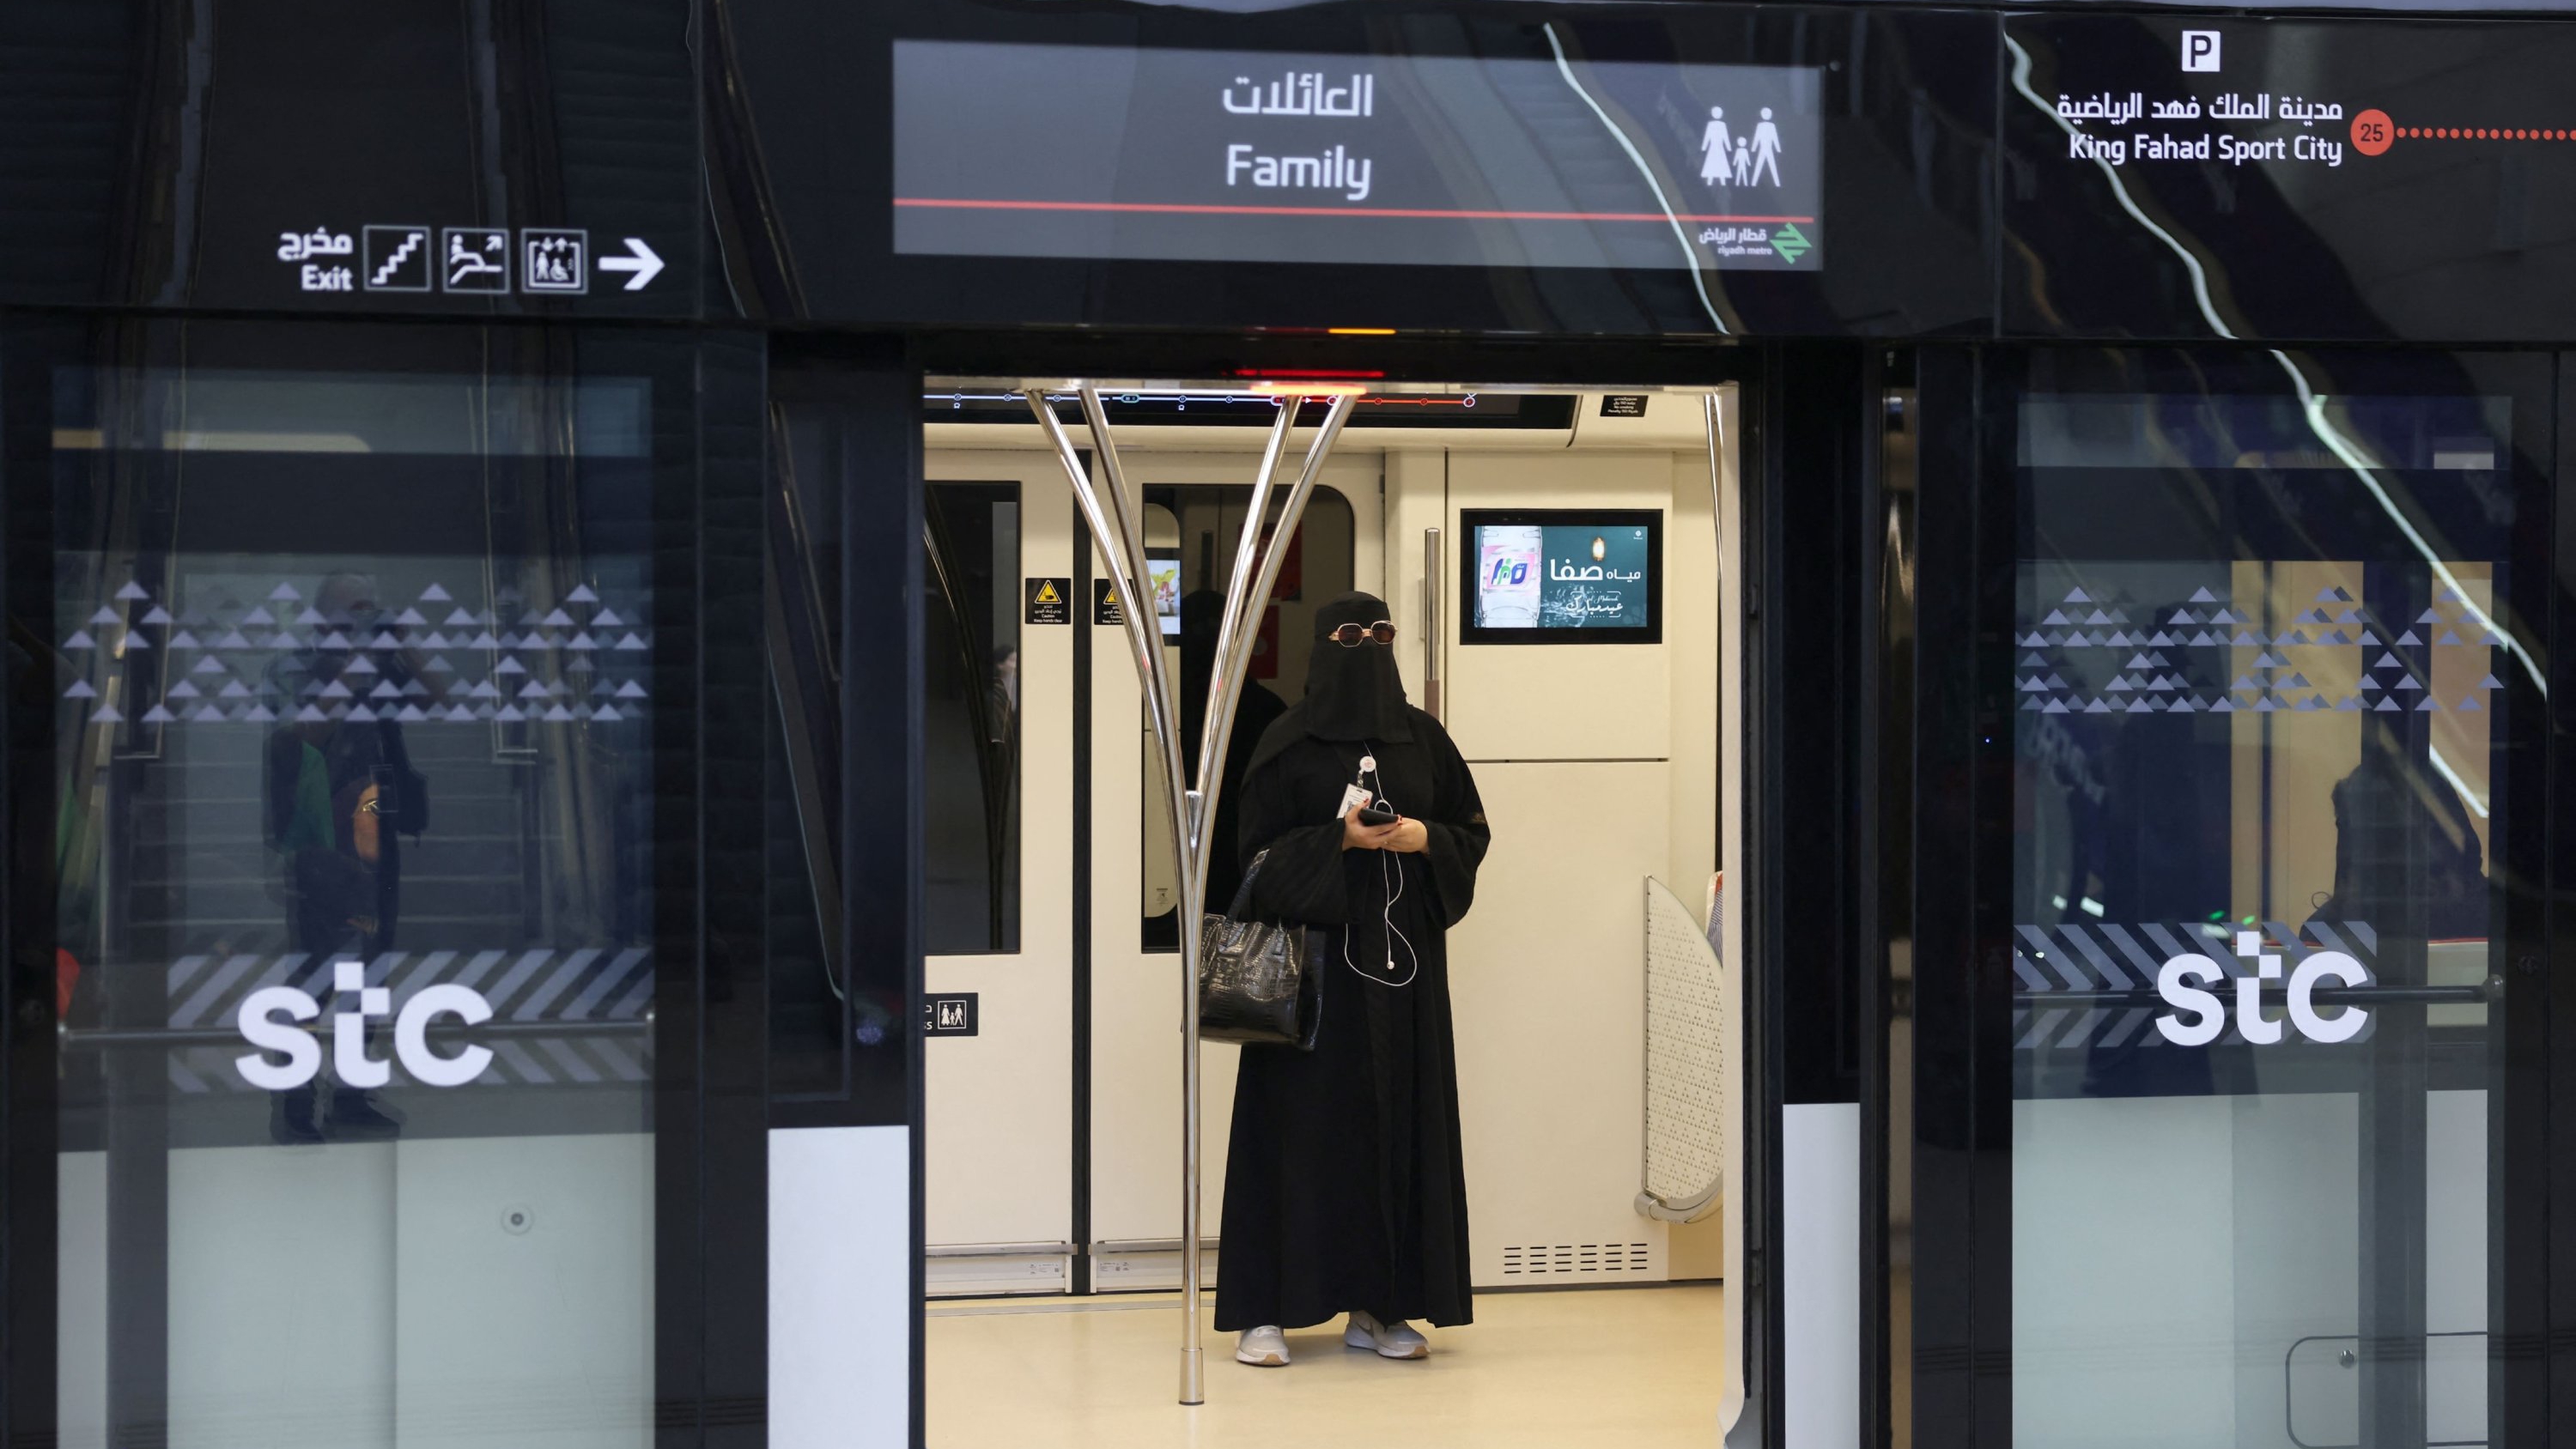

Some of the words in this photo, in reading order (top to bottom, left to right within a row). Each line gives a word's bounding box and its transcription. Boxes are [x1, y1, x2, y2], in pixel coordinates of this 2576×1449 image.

[1223, 72, 1373, 117] العائلات
[2057, 91, 2142, 125] الرياضية
[2150, 95, 2201, 119] فهد
[2208, 94, 2270, 119] الملك
[2279, 95, 2342, 127] مدينة
[2360, 124, 2384, 142] 25
[2069, 133, 2126, 166] King
[2135, 133, 2209, 160] Fahad
[2218, 135, 2286, 167] Sport
[2293, 135, 2342, 167] City
[1227, 143, 1371, 201] Family
[277, 226, 353, 261] مخرج
[1698, 227, 1736, 245] الرياض
[1738, 227, 1768, 244] قطار
[1717, 246, 1746, 257] riyadh
[1747, 246, 1772, 256] metro
[301, 264, 354, 291] Exit
[1550, 558, 1603, 581] صفا
[2155, 931, 2368, 1046] stc
[235, 961, 494, 1090] stc
